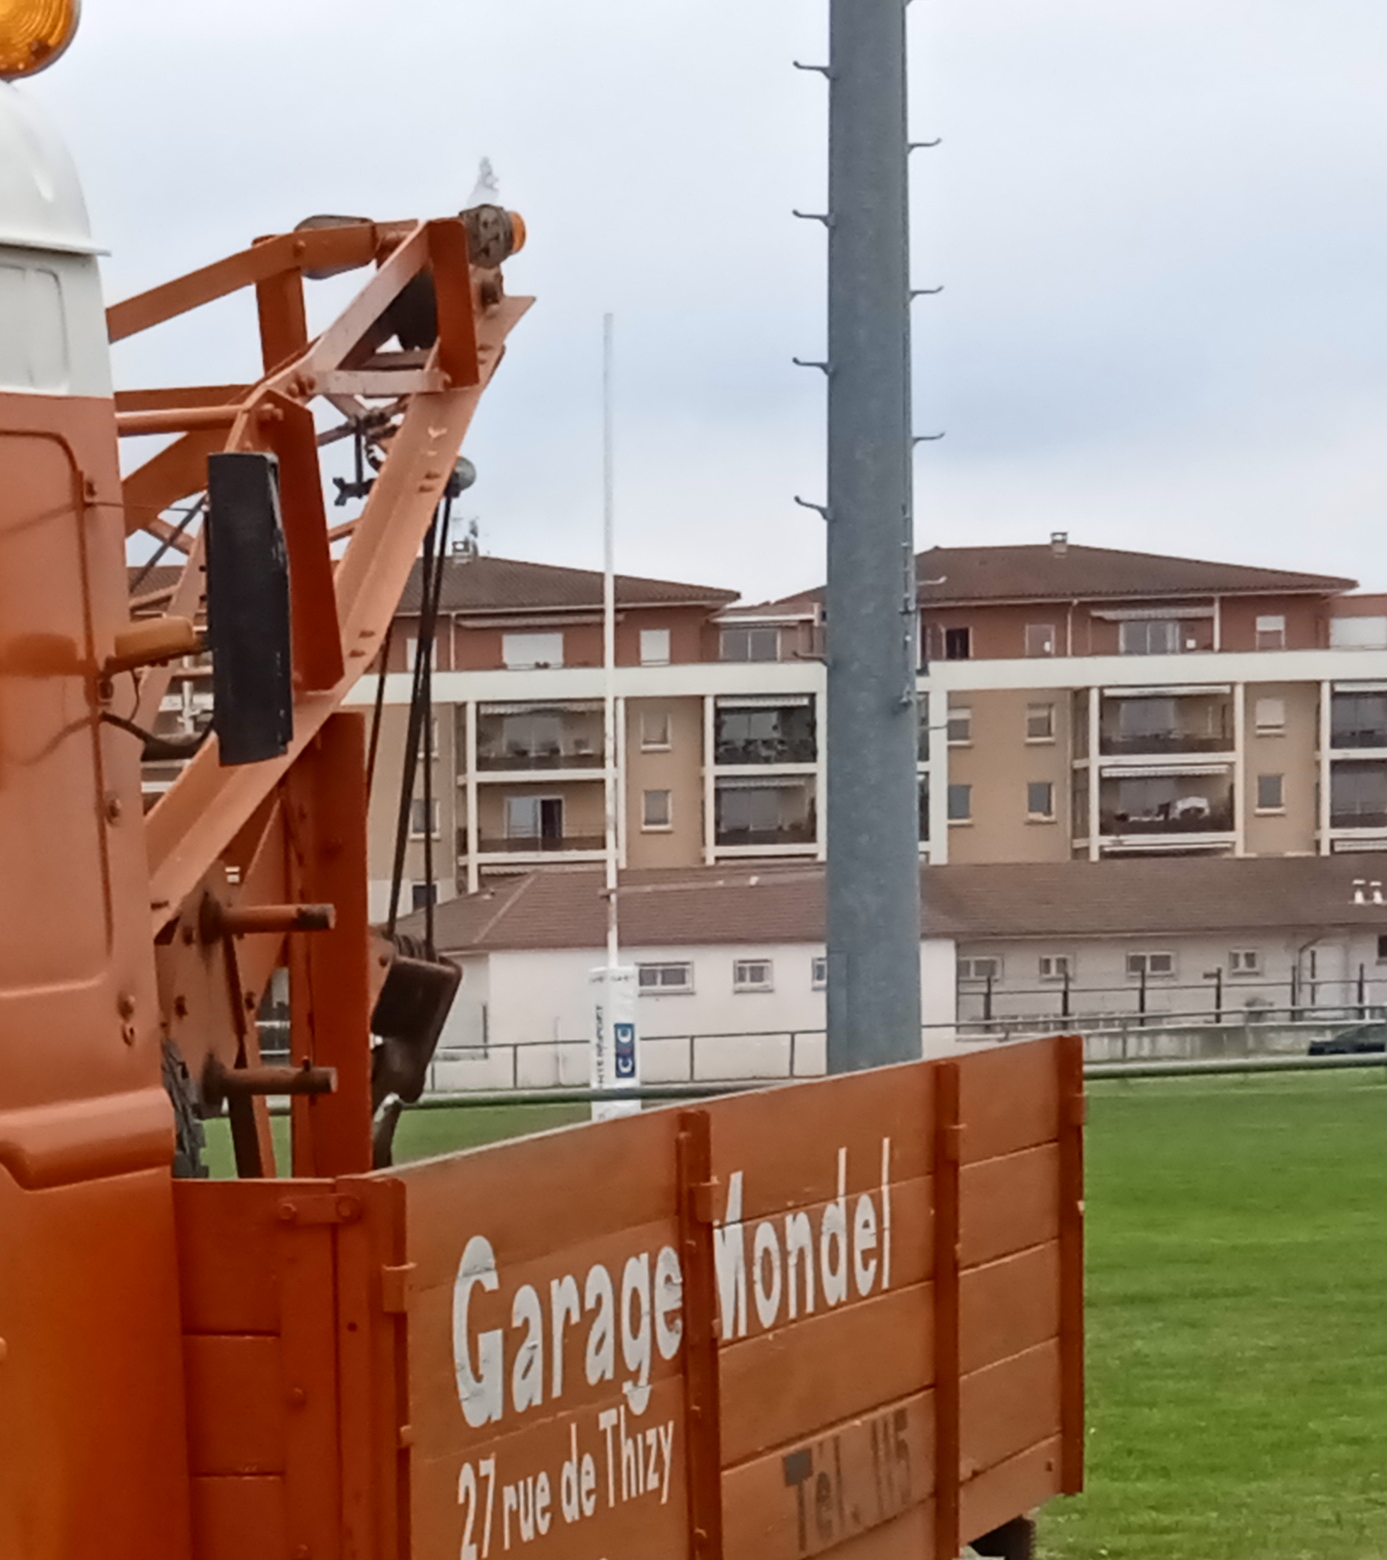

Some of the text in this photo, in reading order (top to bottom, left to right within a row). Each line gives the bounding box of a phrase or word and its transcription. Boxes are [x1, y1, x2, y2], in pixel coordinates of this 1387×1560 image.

[453, 1235, 683, 1428] Garage
[502, 1470, 552, 1551] rue
[560, 1422, 597, 1524] de
[598, 1403, 675, 1509] Thizy
